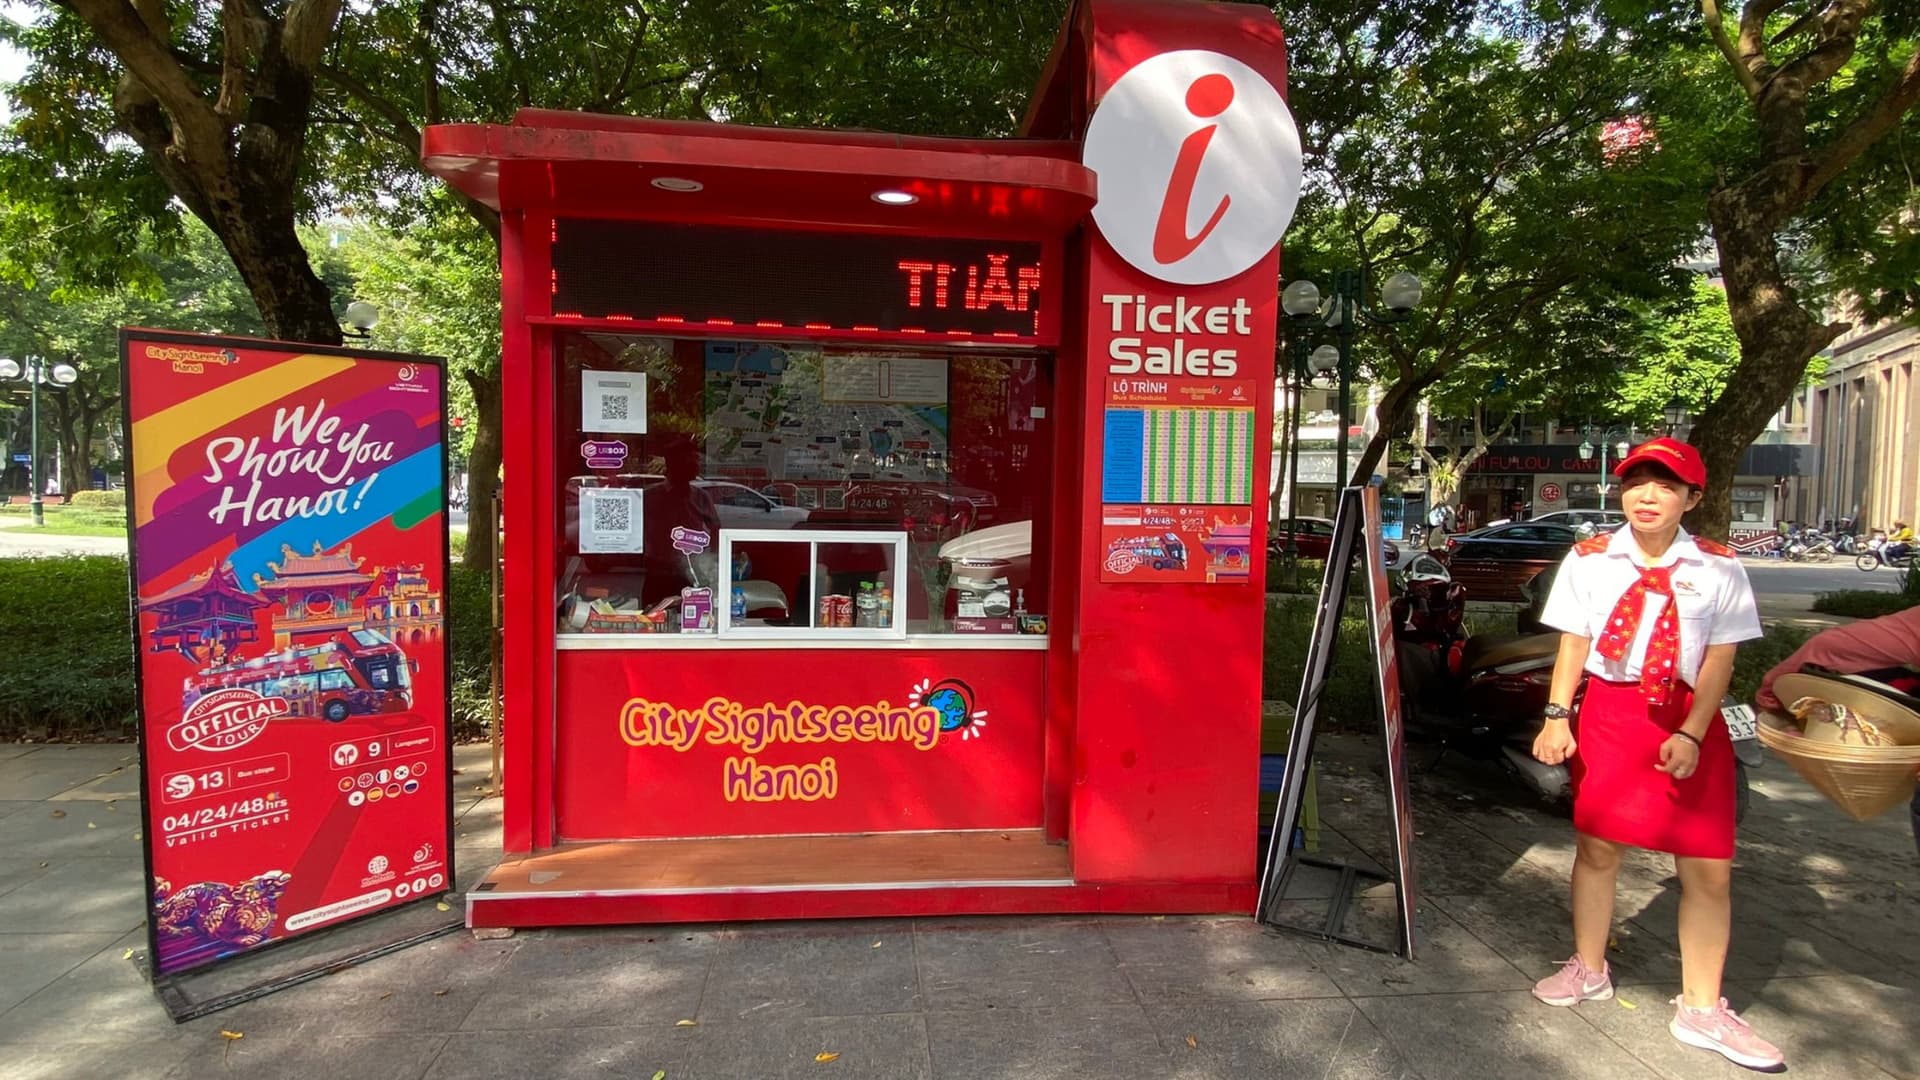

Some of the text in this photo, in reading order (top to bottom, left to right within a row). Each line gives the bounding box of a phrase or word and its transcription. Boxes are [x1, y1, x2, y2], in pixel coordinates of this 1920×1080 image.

[1102, 294, 1251, 335] Ticket
[172, 361, 205, 374] Hanoi
[1109, 337, 1238, 377] Sales
[1131, 379, 1168, 393] TRÌNH
[272, 398, 341, 446] We
[203, 423, 395, 485] Show You
[208, 472, 379, 527] Hanoi!
[181, 700, 283, 742] OFFICIAL
[216, 723, 260, 746] TOUR
[620, 697, 941, 753] CitySightseeing
[368, 742, 381, 757] 9
[198, 771, 224, 790] 13
[723, 757, 838, 801] Hanoi
[166, 813, 289, 848] Valid Ticket
